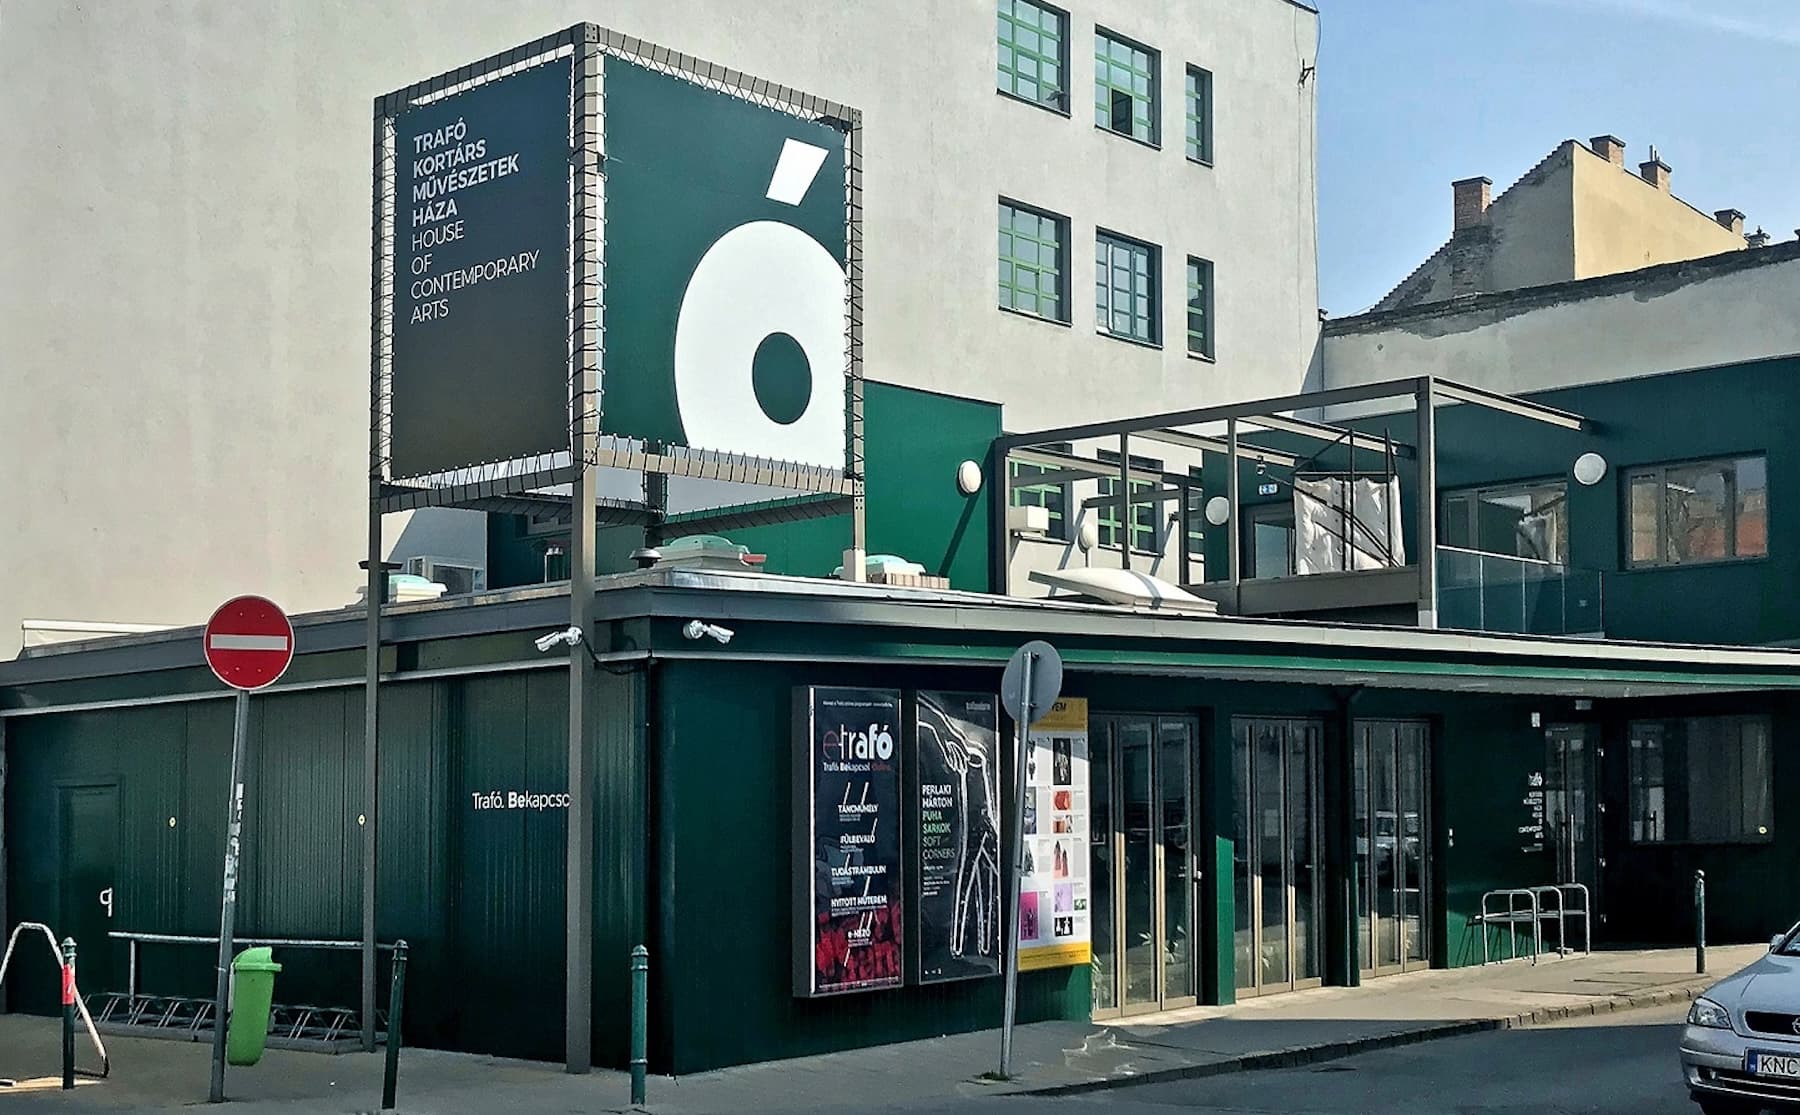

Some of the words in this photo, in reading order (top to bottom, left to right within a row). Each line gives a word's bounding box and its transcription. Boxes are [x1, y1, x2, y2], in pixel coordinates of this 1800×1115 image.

[413, 117, 467, 154] TRAFÓ
[413, 139, 487, 179] KORTÁRS
[413, 153, 520, 203] MŰVÉSZETEK
[412, 199, 458, 227] HÁZA
[411, 220, 465, 251] HOUSE
[410, 249, 540, 300] CONTEMPORARY
[411, 253, 433, 275] OF
[410, 299, 449, 324] ARTS
[472, 790, 504, 810] Trafó.
[1761, 1055, 1798, 1075] KNC
